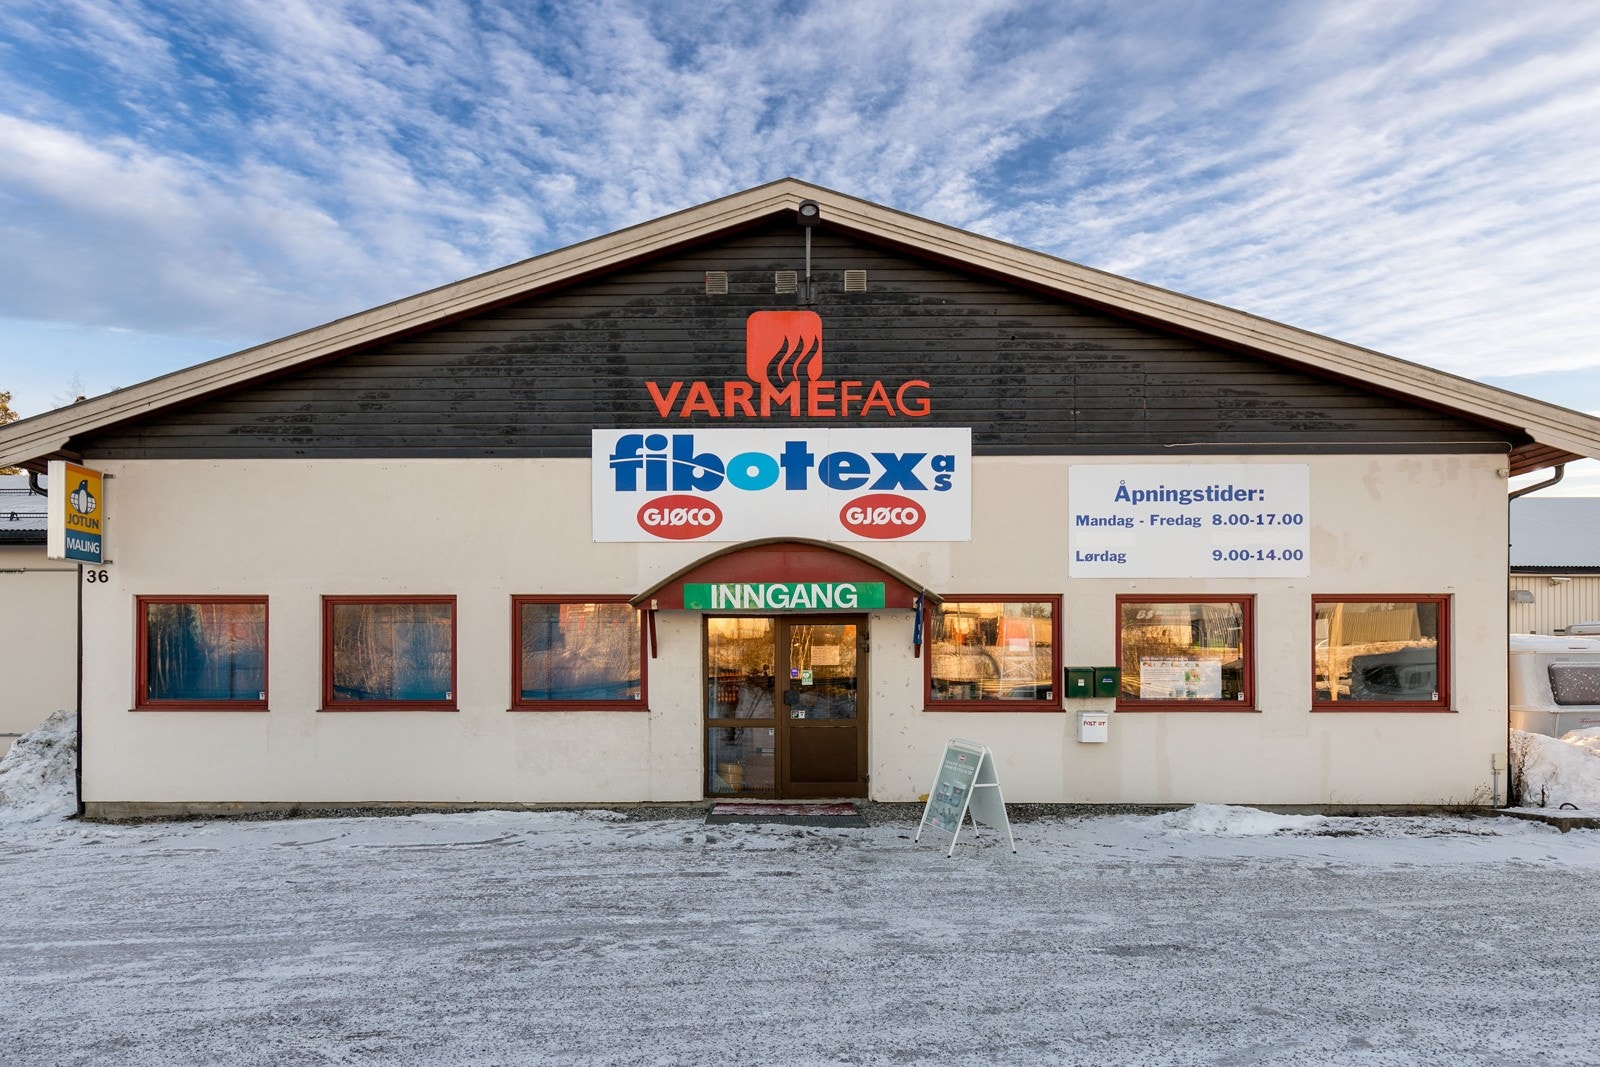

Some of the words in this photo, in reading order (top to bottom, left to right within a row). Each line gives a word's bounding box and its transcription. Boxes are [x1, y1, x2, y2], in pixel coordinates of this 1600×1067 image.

[645, 380, 932, 418] VARMEFAG
[609, 433, 928, 492] fibotex
[1114, 479, 1265, 505] Åpningstider:
[67, 513, 99, 530] JOTUN
[643, 507, 716, 526] GJØCO
[846, 506, 919, 526] GJØCO
[1075, 514, 1135, 528] Mandag
[1150, 514, 1202, 528] Fredag
[1211, 513, 1304, 526] 8.00-17.00
[66, 537, 100, 554] MALING
[1075, 550, 1127, 564] Lørdag
[1212, 549, 1304, 561] 9.00-14.00
[86, 569, 109, 583] 36
[711, 583, 858, 609] INNGANG
